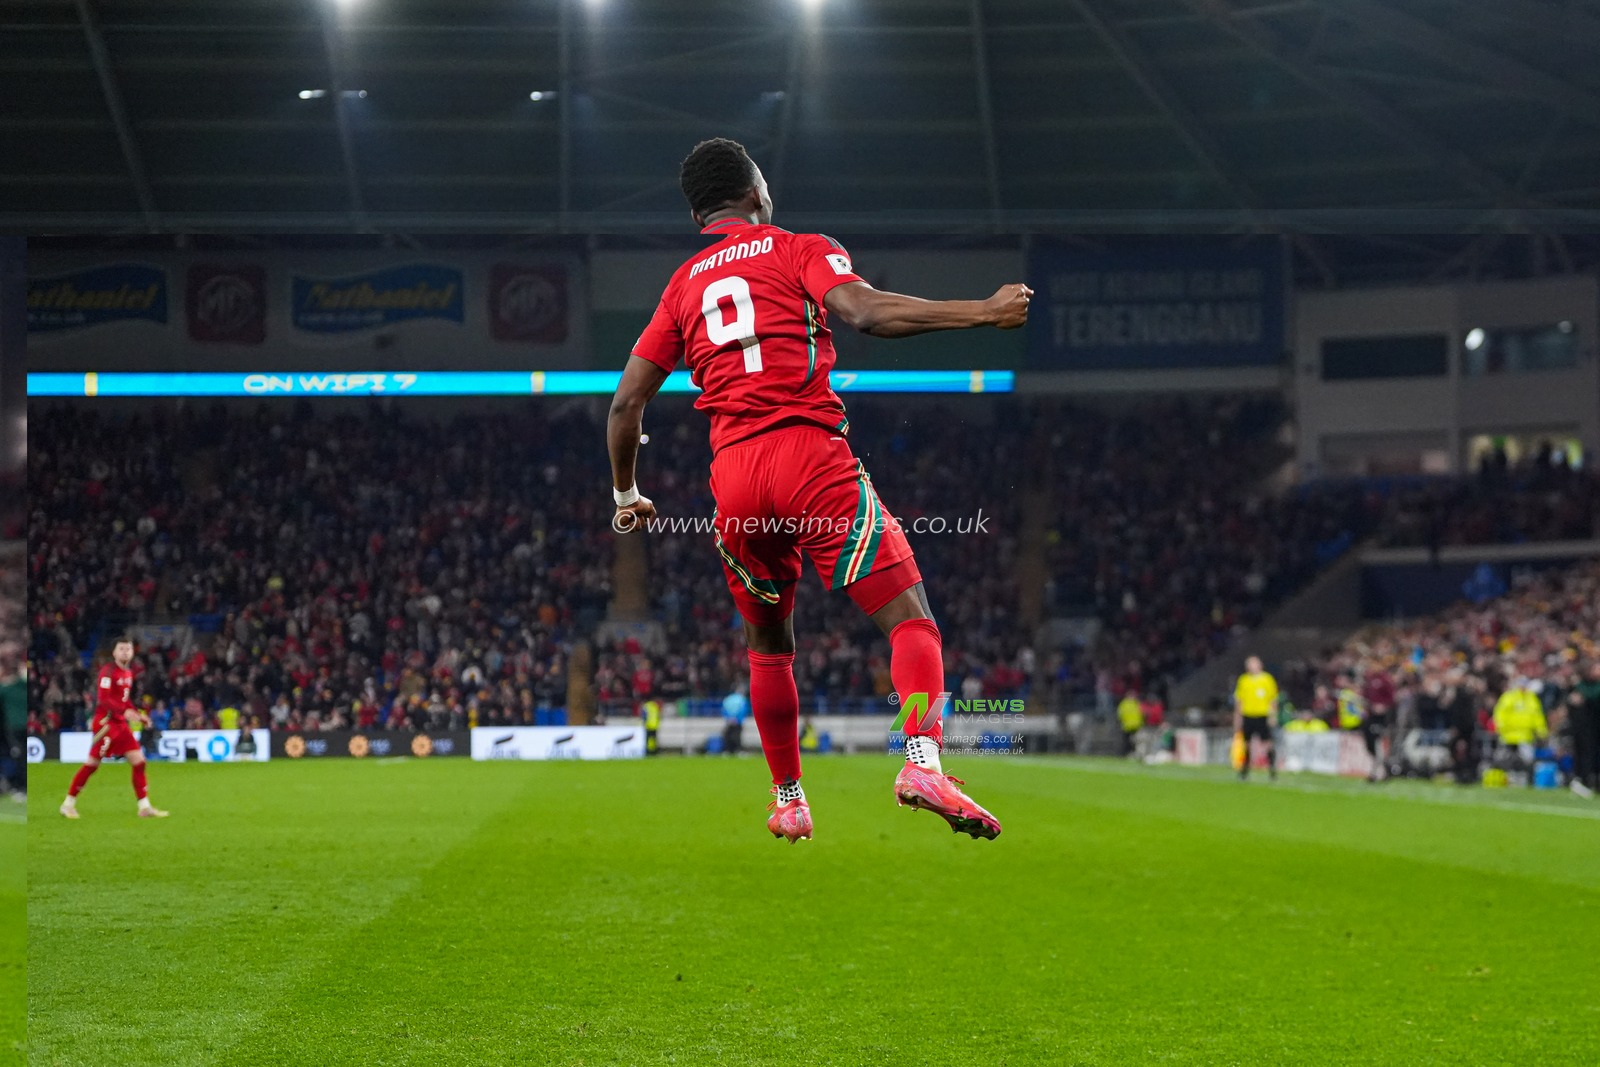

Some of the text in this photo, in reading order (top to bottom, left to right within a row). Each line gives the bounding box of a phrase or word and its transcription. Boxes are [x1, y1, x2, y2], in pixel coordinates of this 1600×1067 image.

[689, 236, 773, 280] MATONDO
[701, 275, 763, 373] 9
[243, 374, 417, 393] ON WIFI 7
[834, 373, 858, 389] 7
